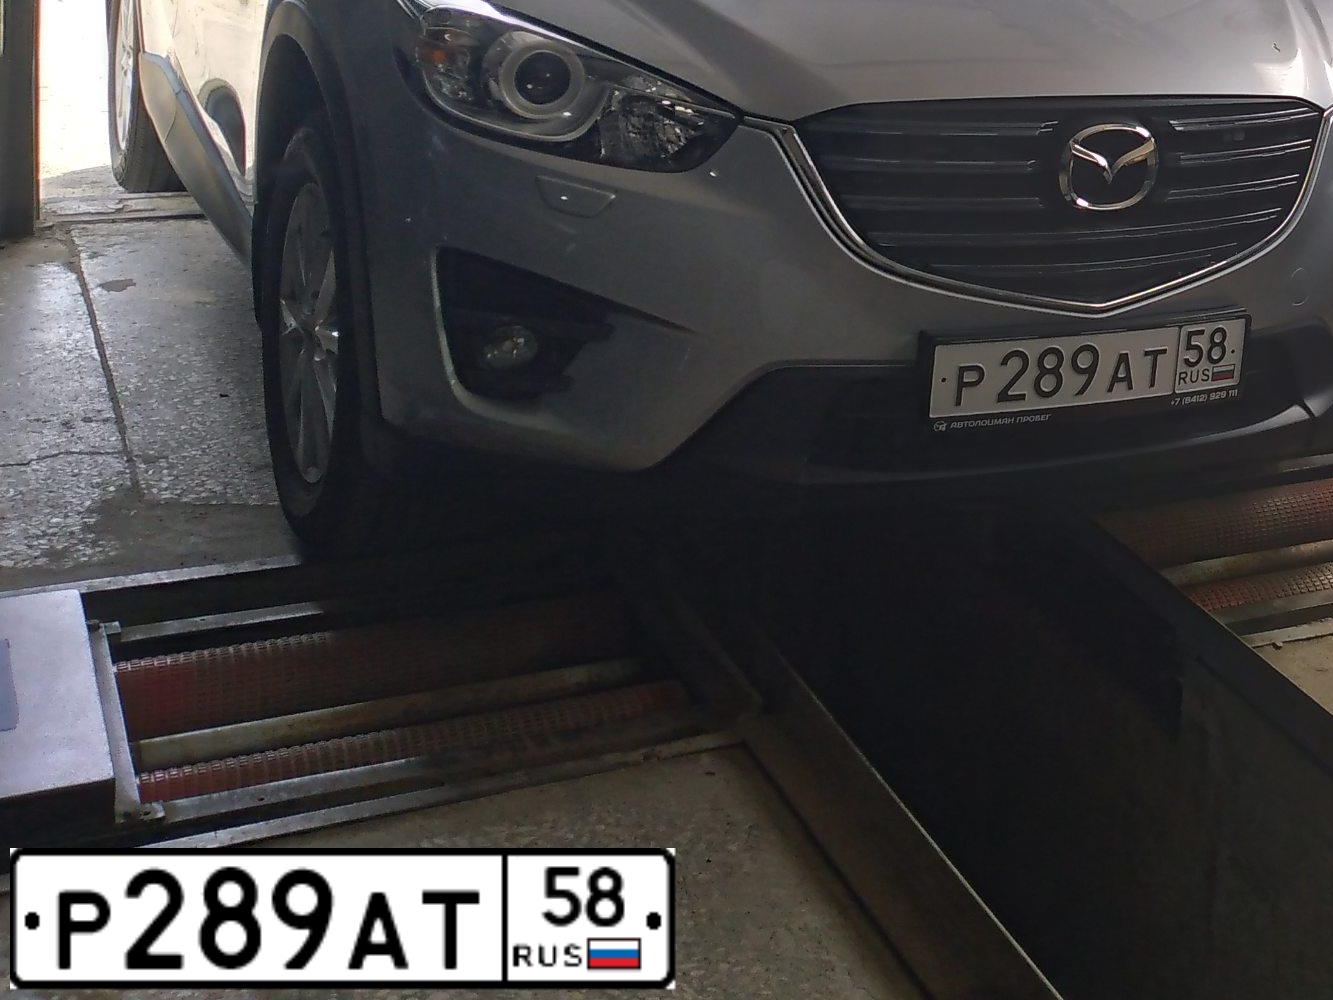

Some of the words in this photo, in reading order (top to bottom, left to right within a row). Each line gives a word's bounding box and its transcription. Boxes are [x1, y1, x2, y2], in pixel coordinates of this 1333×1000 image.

[1183, 326, 1228, 368] 58
[1178, 367, 1211, 386] RUS
[1016, 413, 1052, 424] ПРОБЕГ
